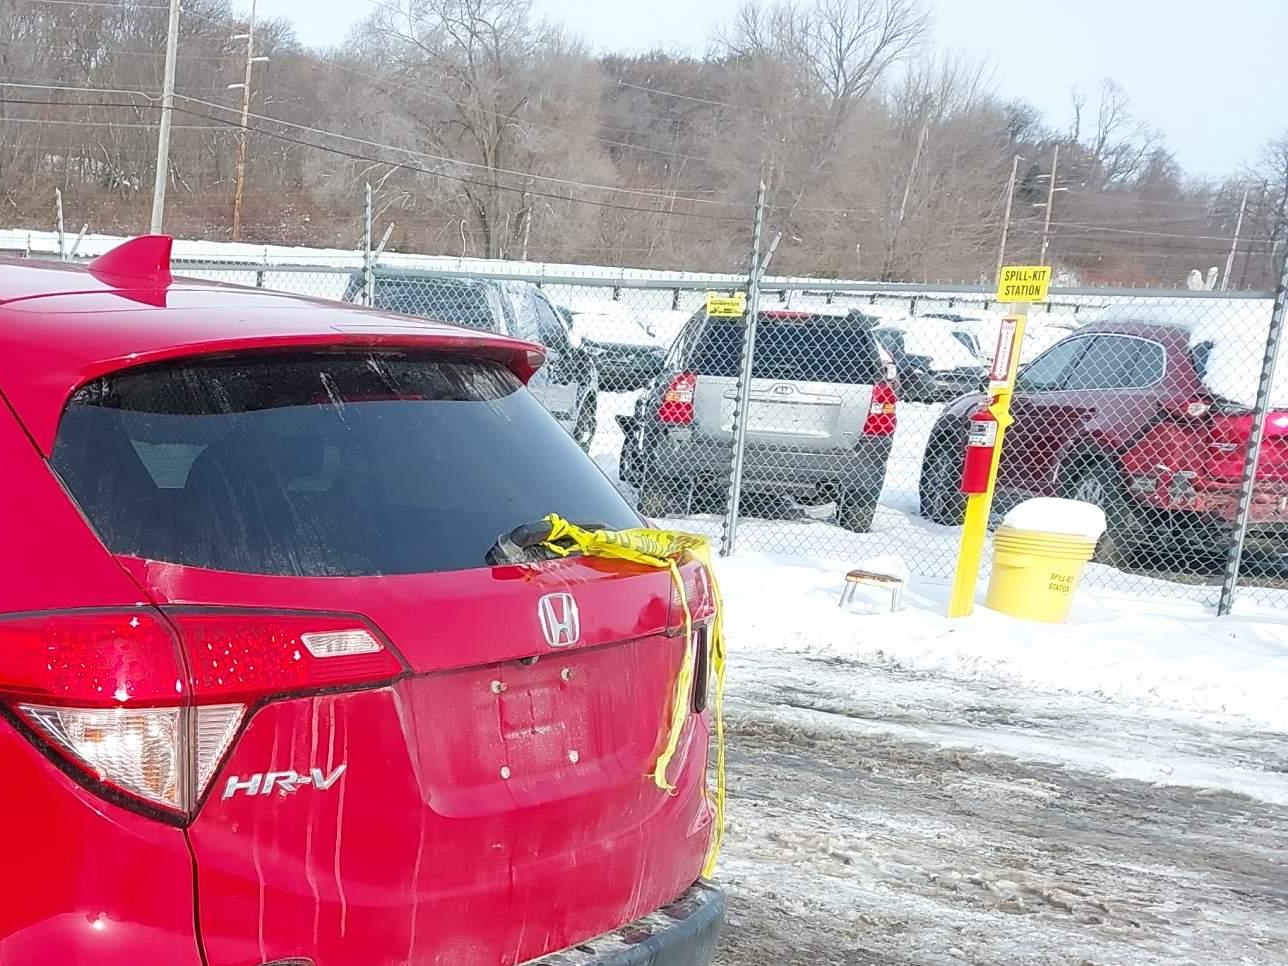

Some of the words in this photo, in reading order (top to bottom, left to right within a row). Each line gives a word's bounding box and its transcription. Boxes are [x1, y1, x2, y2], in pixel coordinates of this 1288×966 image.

[1004, 270, 1047, 281] SPILL-KIT
[1004, 285, 1042, 296] STATION
[223, 764, 347, 799] HR-V
